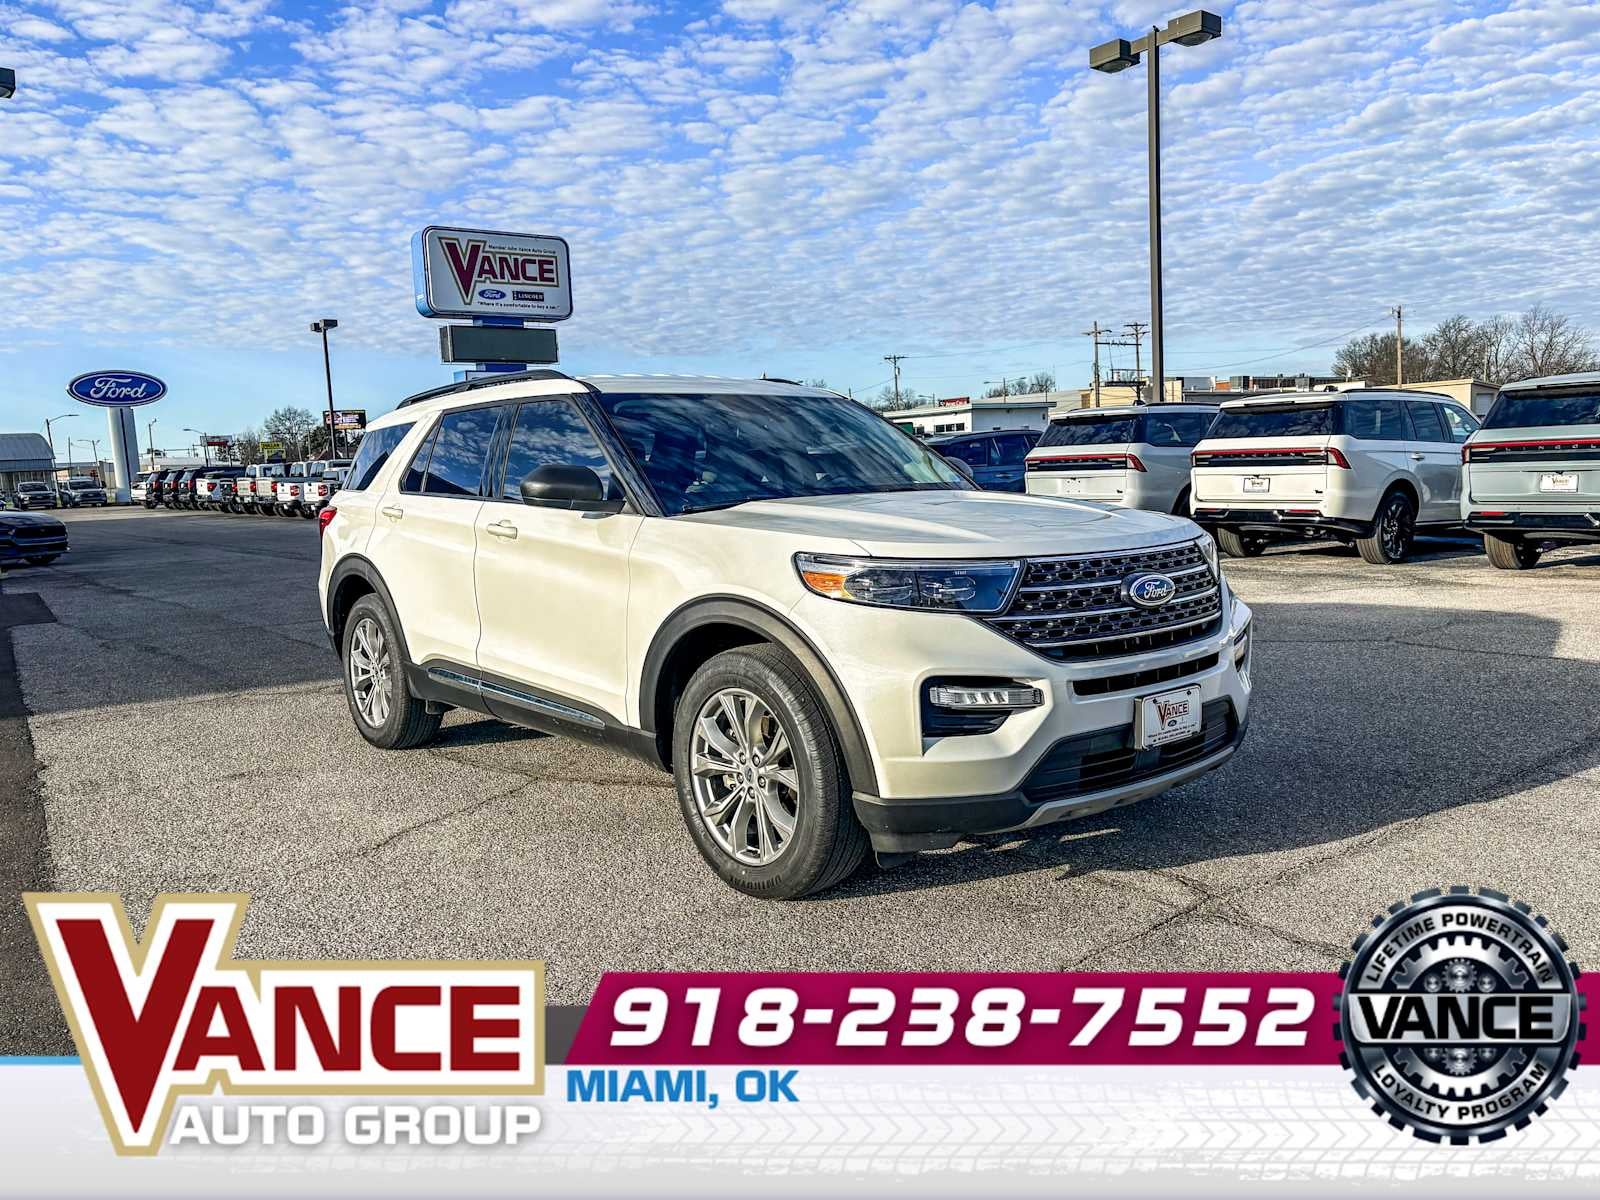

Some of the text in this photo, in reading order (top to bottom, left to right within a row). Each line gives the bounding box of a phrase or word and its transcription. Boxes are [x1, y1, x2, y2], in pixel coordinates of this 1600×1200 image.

[444, 242, 555, 298] VANCE
[90, 377, 147, 399] Ford
[1143, 581, 1167, 599] Ford
[1157, 702, 1188, 726] VANCE
